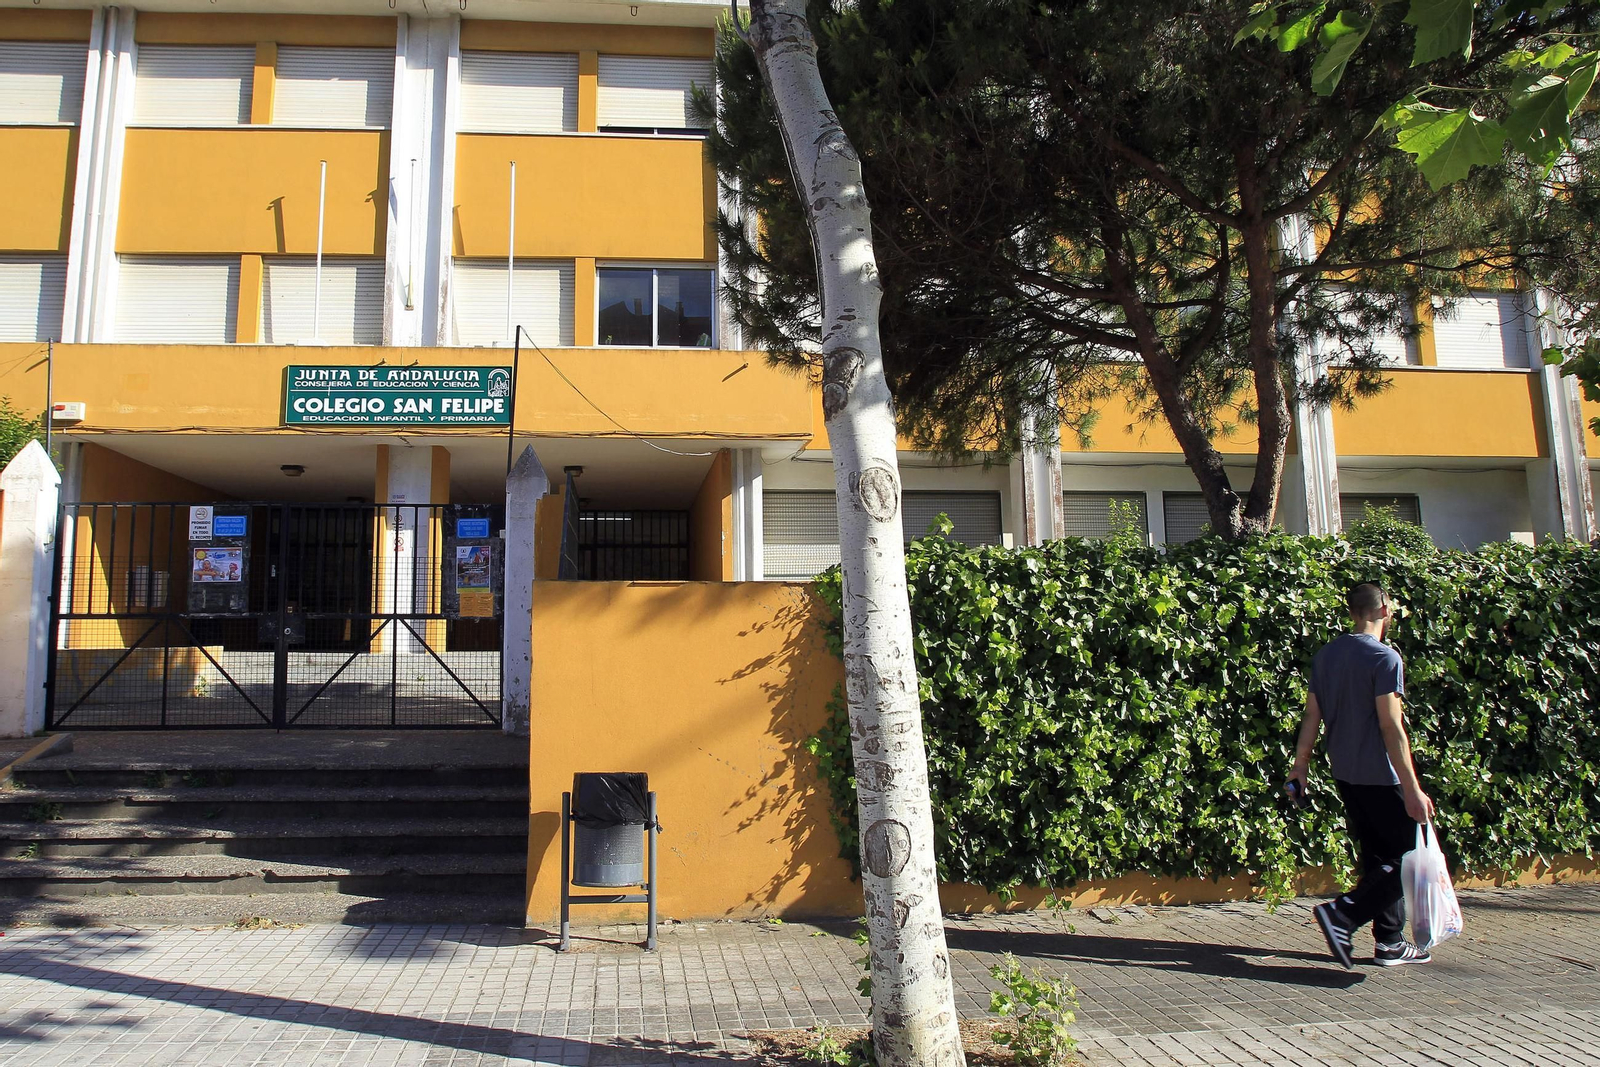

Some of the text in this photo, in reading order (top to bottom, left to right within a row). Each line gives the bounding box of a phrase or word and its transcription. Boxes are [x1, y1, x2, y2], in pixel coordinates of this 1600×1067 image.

[294, 369, 480, 381] JUNTA DE ANDALUCIA
[293, 397, 504, 413] COLEGIO SAN FELIPE
